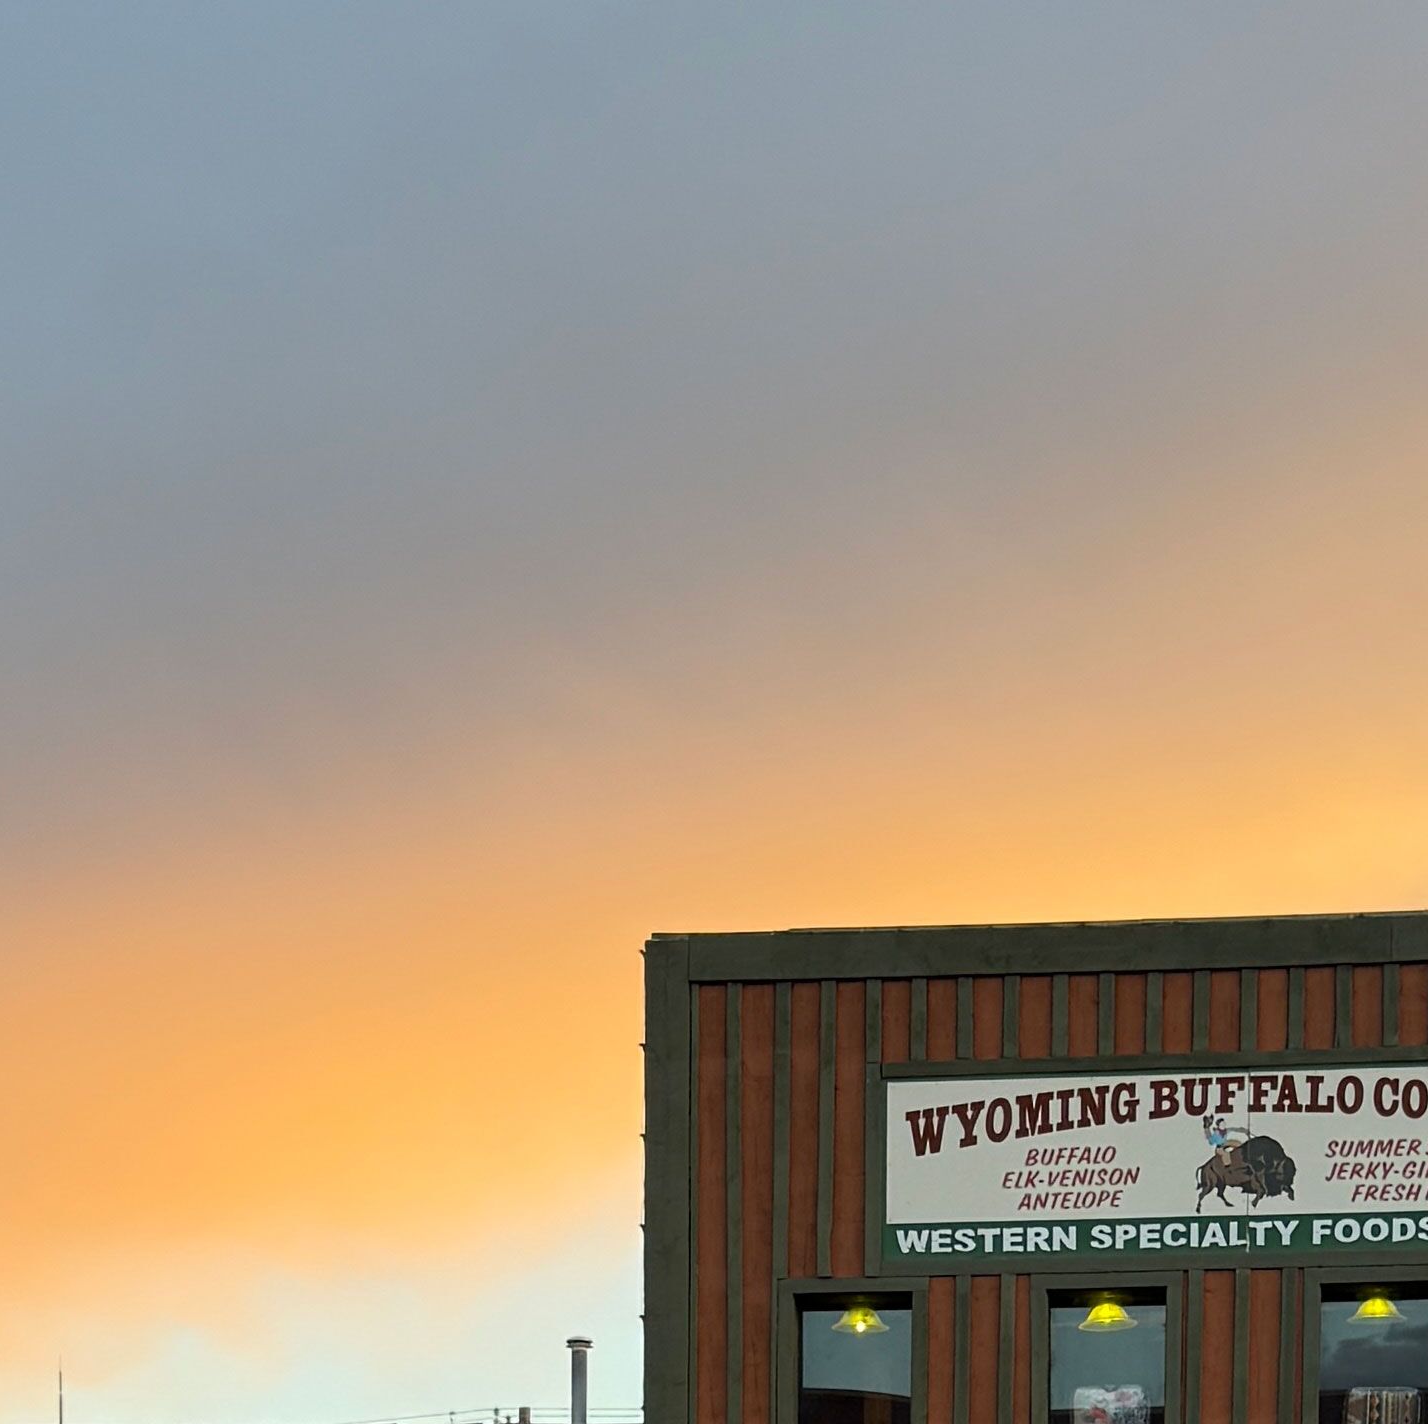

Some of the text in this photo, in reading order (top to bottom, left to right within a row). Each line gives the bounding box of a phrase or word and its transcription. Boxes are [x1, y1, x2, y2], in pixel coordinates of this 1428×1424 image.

[905, 1082, 1140, 1157] WYOMING
[1148, 1075, 1364, 1120] BUFFALO
[1025, 1146, 1117, 1166] BUFFALO
[1325, 1139, 1421, 1158] SUMMER
[1001, 1167, 1140, 1189] ELK-VENISON
[1017, 1190, 1123, 1211] ANTELOPE
[1351, 1183, 1421, 1202] FRESH
[896, 1226, 1077, 1253] WESTERN
[1090, 1220, 1300, 1250] SPECIALTY
